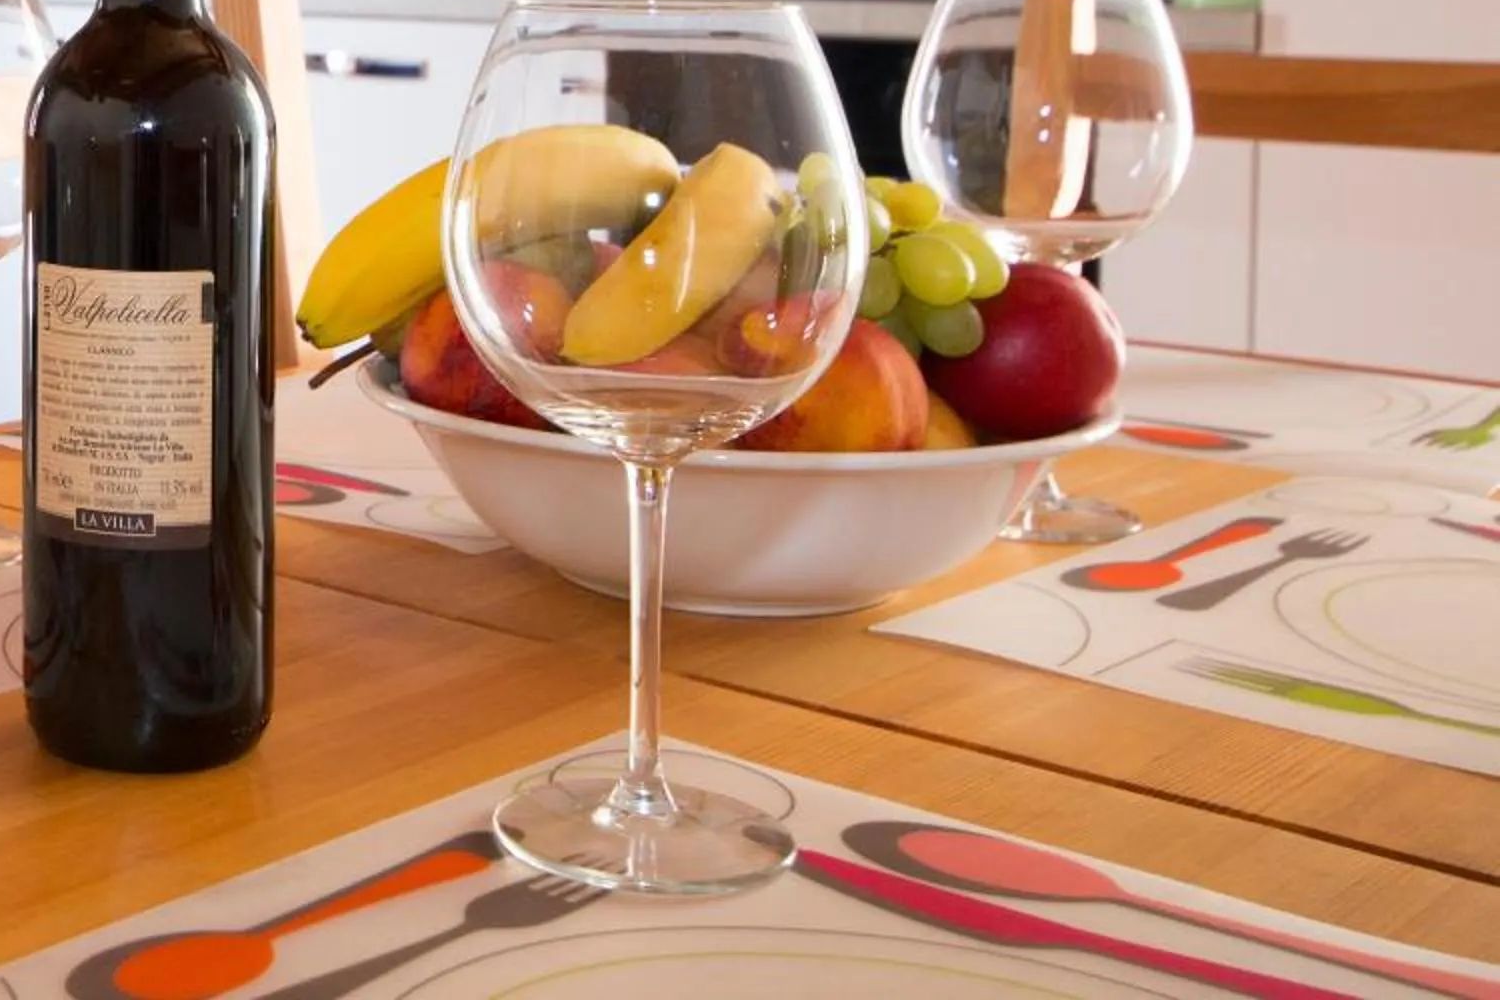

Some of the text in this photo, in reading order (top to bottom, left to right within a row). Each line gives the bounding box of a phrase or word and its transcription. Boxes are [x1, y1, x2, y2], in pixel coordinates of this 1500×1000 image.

[53, 275, 192, 329] Valpolicella
[80, 513, 146, 532] LA VILLA
